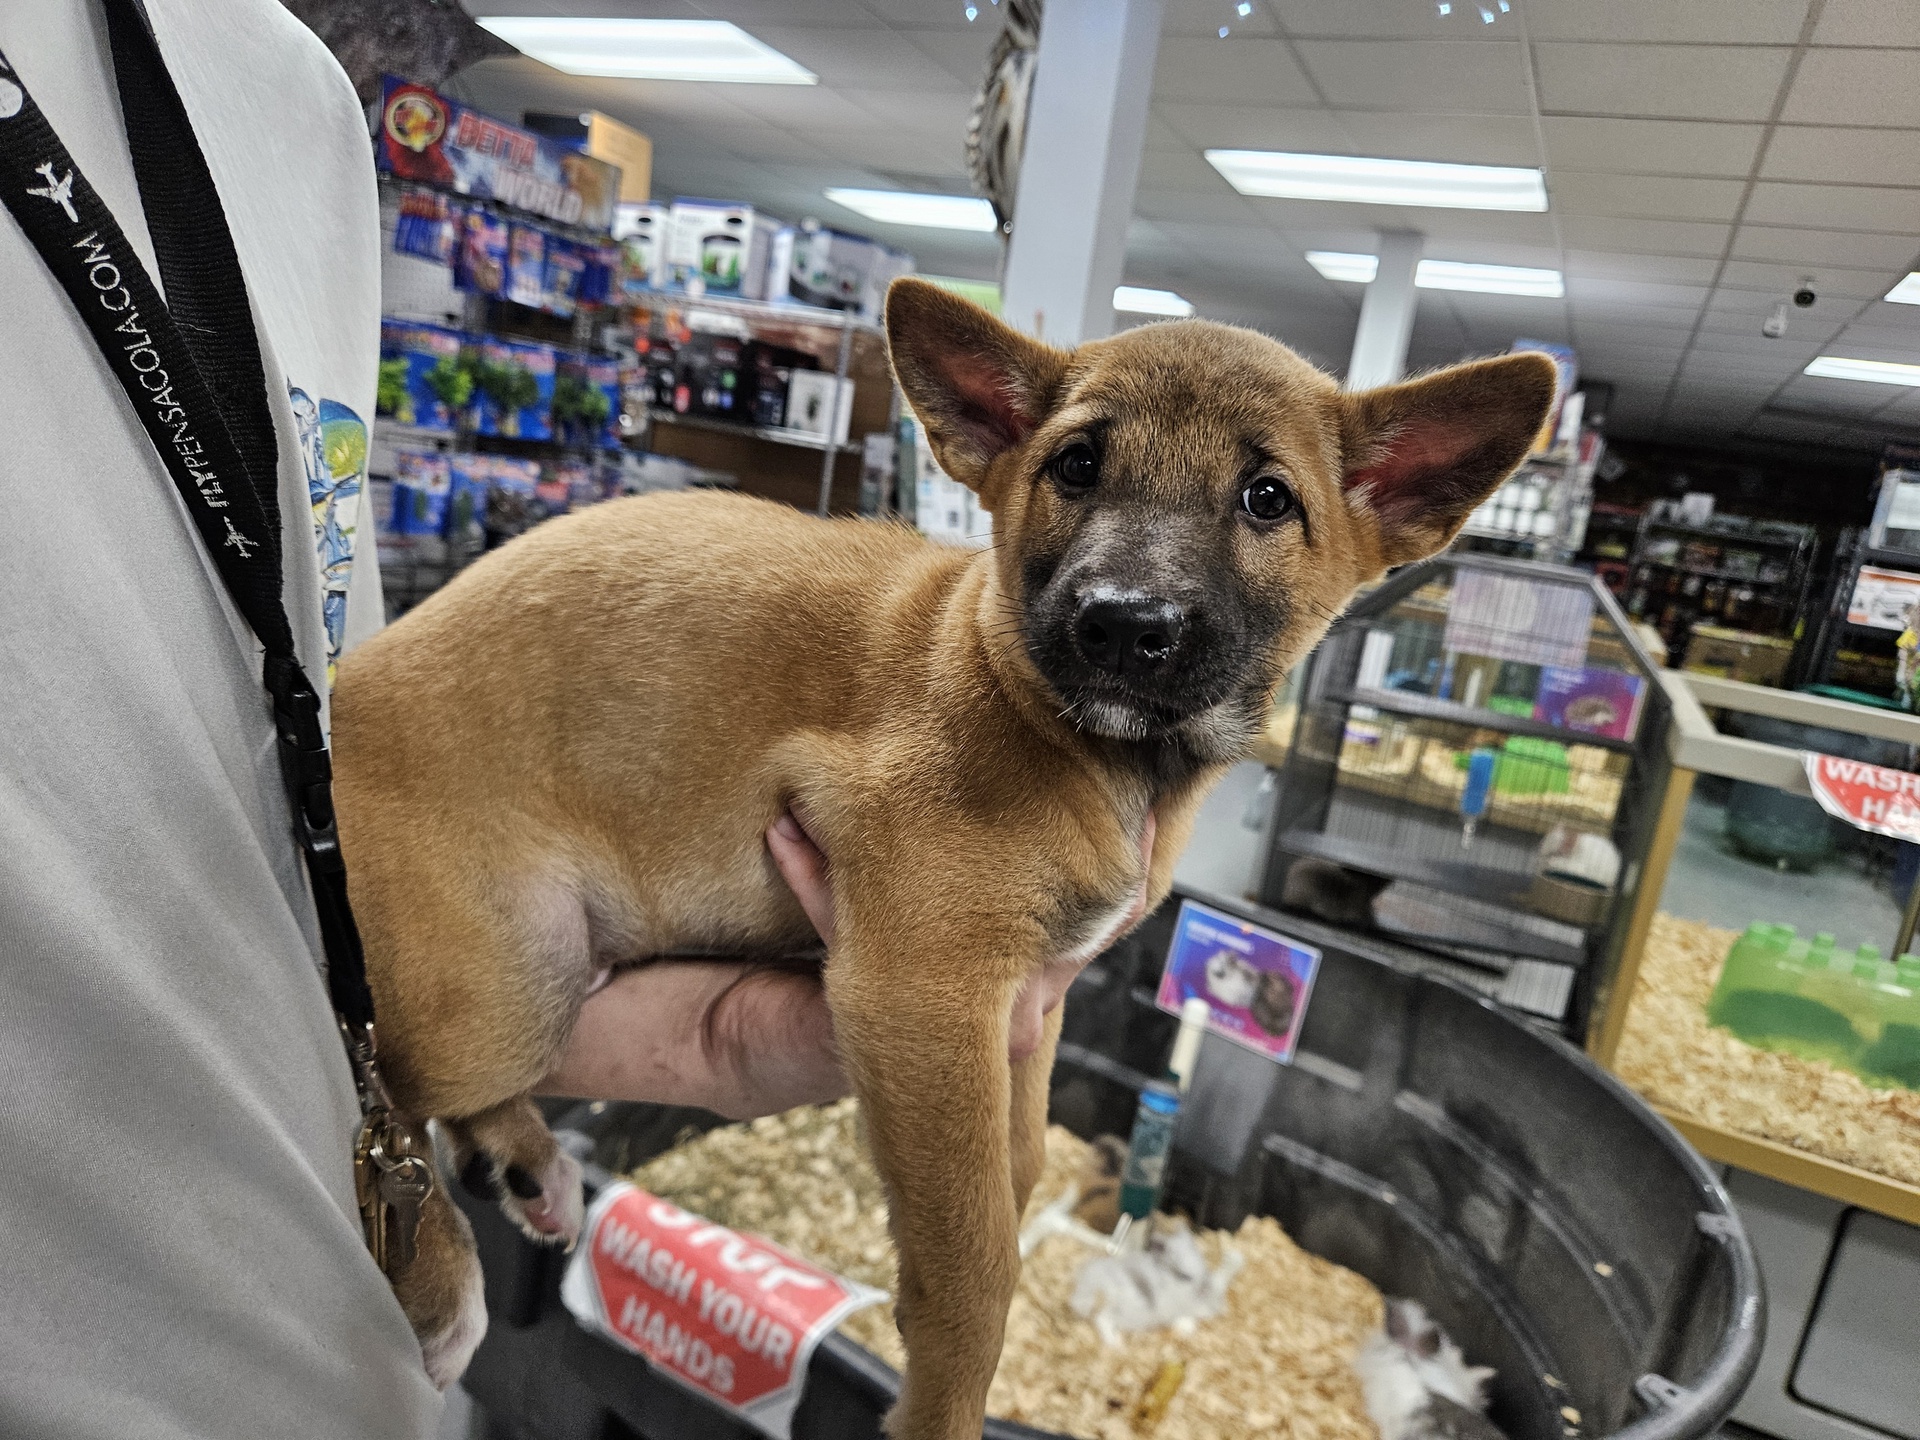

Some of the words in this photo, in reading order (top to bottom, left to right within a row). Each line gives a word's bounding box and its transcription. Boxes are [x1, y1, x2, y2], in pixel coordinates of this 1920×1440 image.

[455, 112, 538, 167] BETTA
[492, 166, 584, 225] WORLD
[73, 231, 230, 508] FLYPENSACOLA.COM
[1824, 759, 1920, 799] WASH
[601, 1216, 698, 1305] WASH
[699, 1279, 794, 1370] YOUR
[620, 1296, 737, 1393] HANDS
